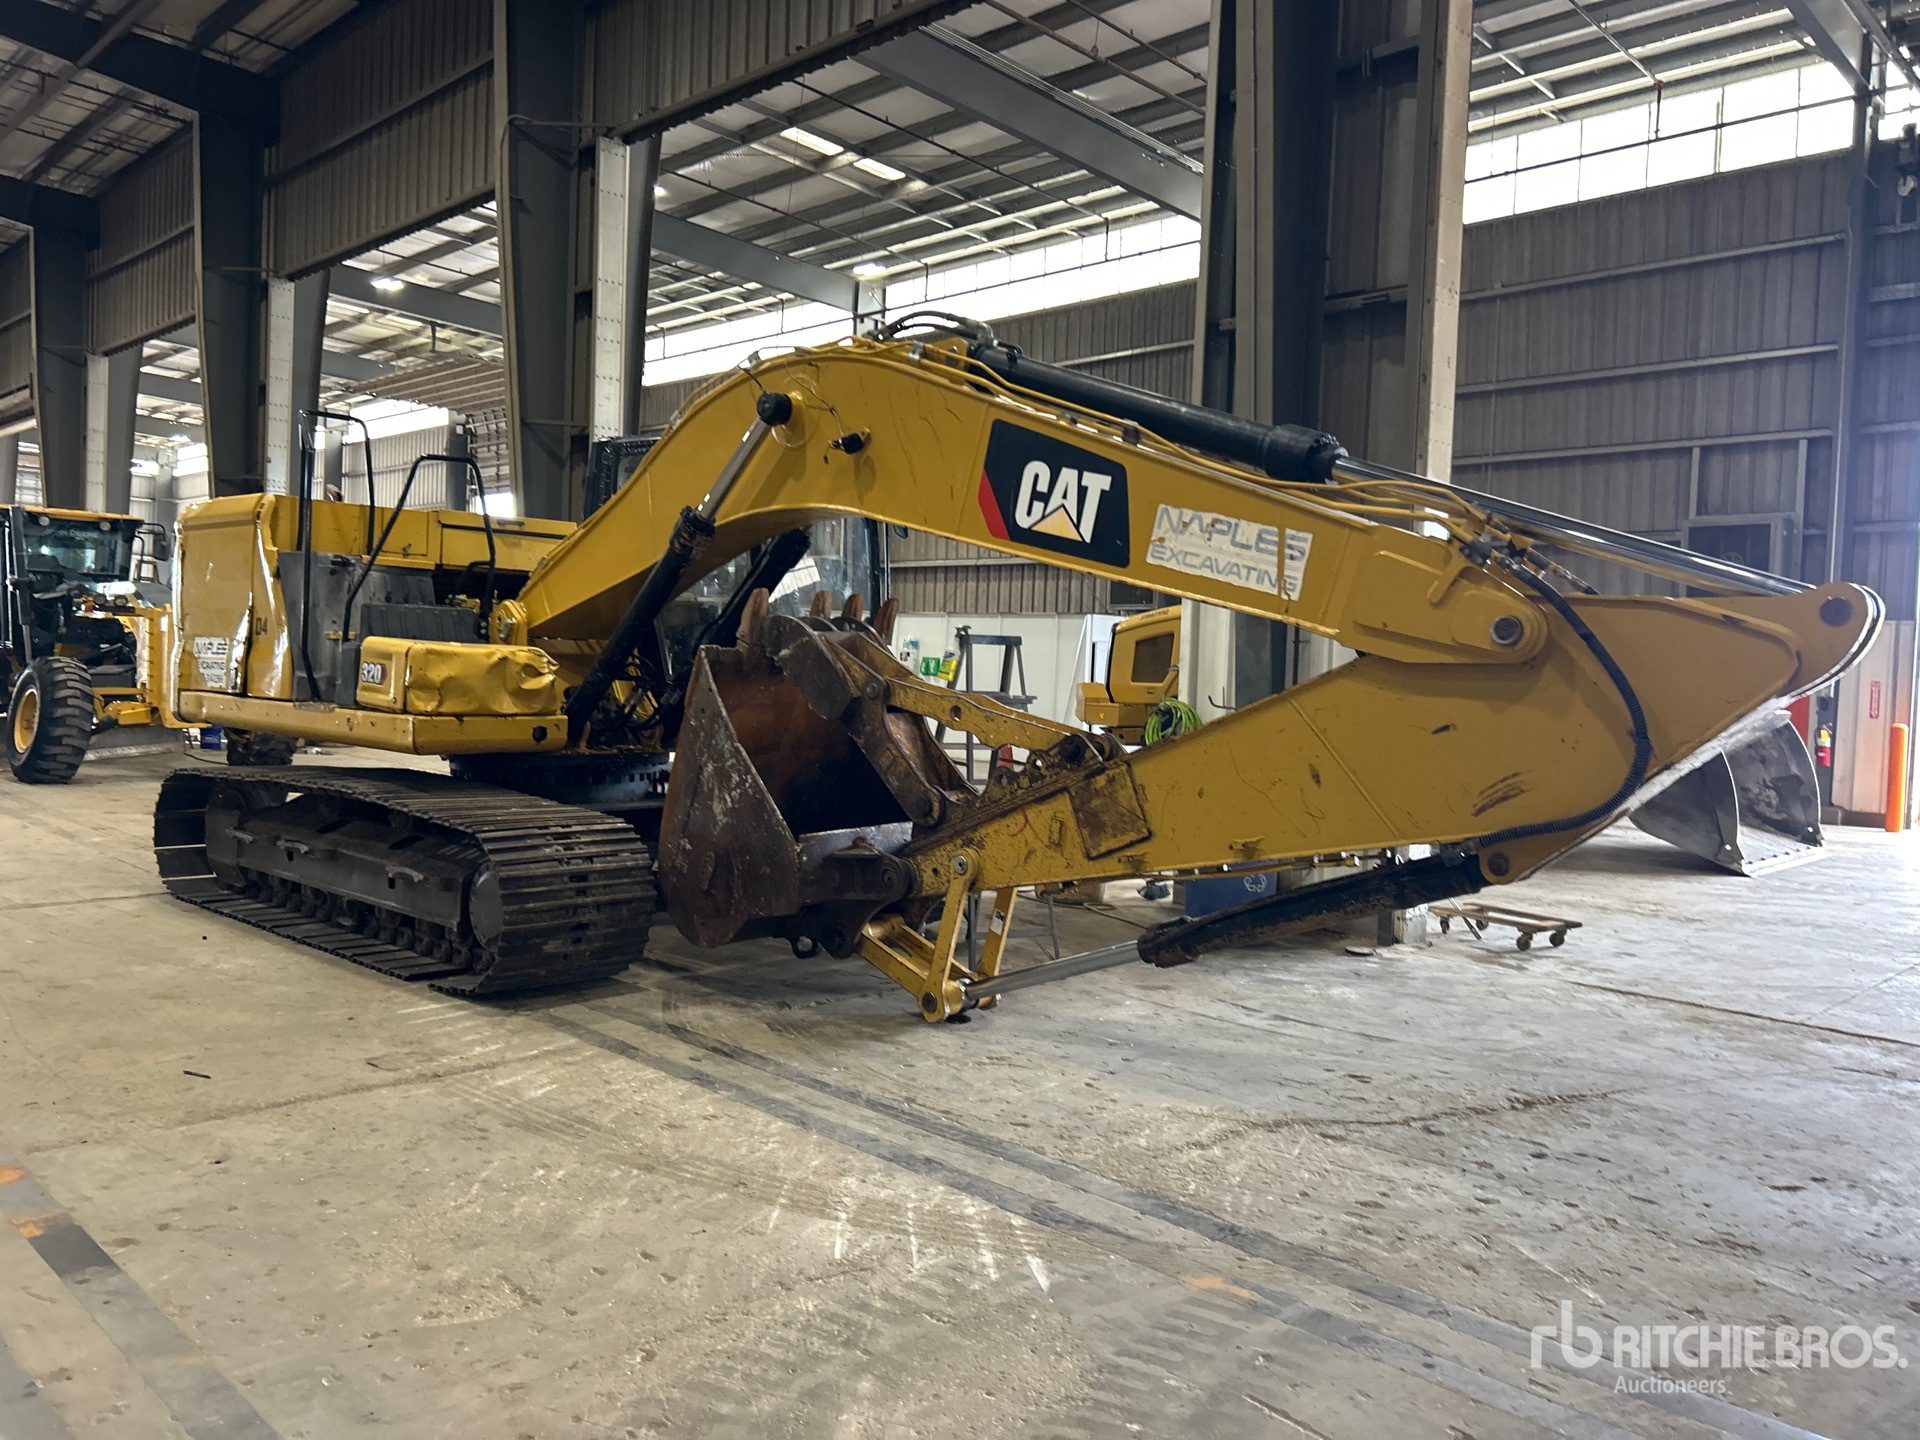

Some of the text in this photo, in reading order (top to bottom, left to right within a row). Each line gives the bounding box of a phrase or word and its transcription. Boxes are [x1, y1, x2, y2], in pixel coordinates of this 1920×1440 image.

[1015, 460, 1112, 544] CAT
[1157, 506, 1309, 562] NAPLES
[1150, 544, 1299, 593] EXCAVATING
[361, 661, 382, 684] 320
